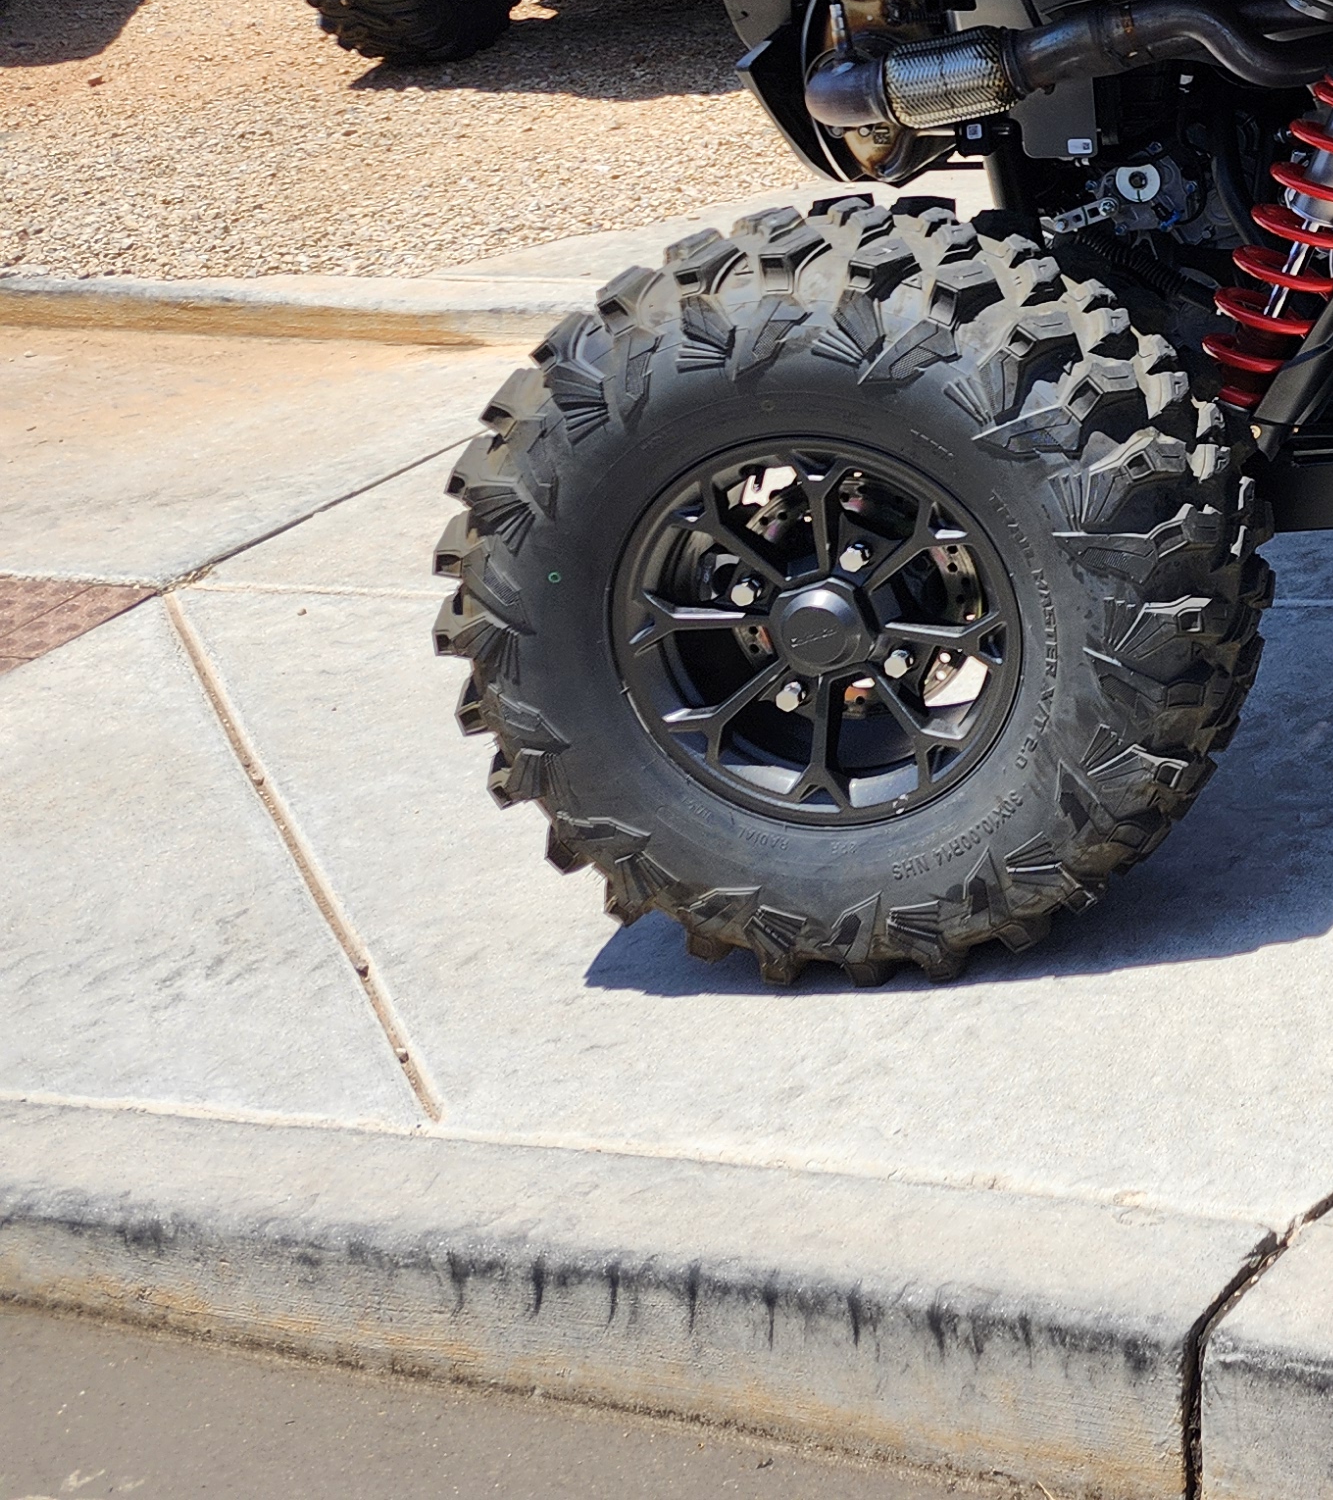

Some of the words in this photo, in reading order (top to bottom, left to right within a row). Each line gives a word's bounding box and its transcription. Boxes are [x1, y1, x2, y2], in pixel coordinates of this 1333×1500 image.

[1031, 567, 1058, 679] MASTER
[891, 851, 931, 882] NHS
[932, 788, 1025, 868] 30X10.00R14
